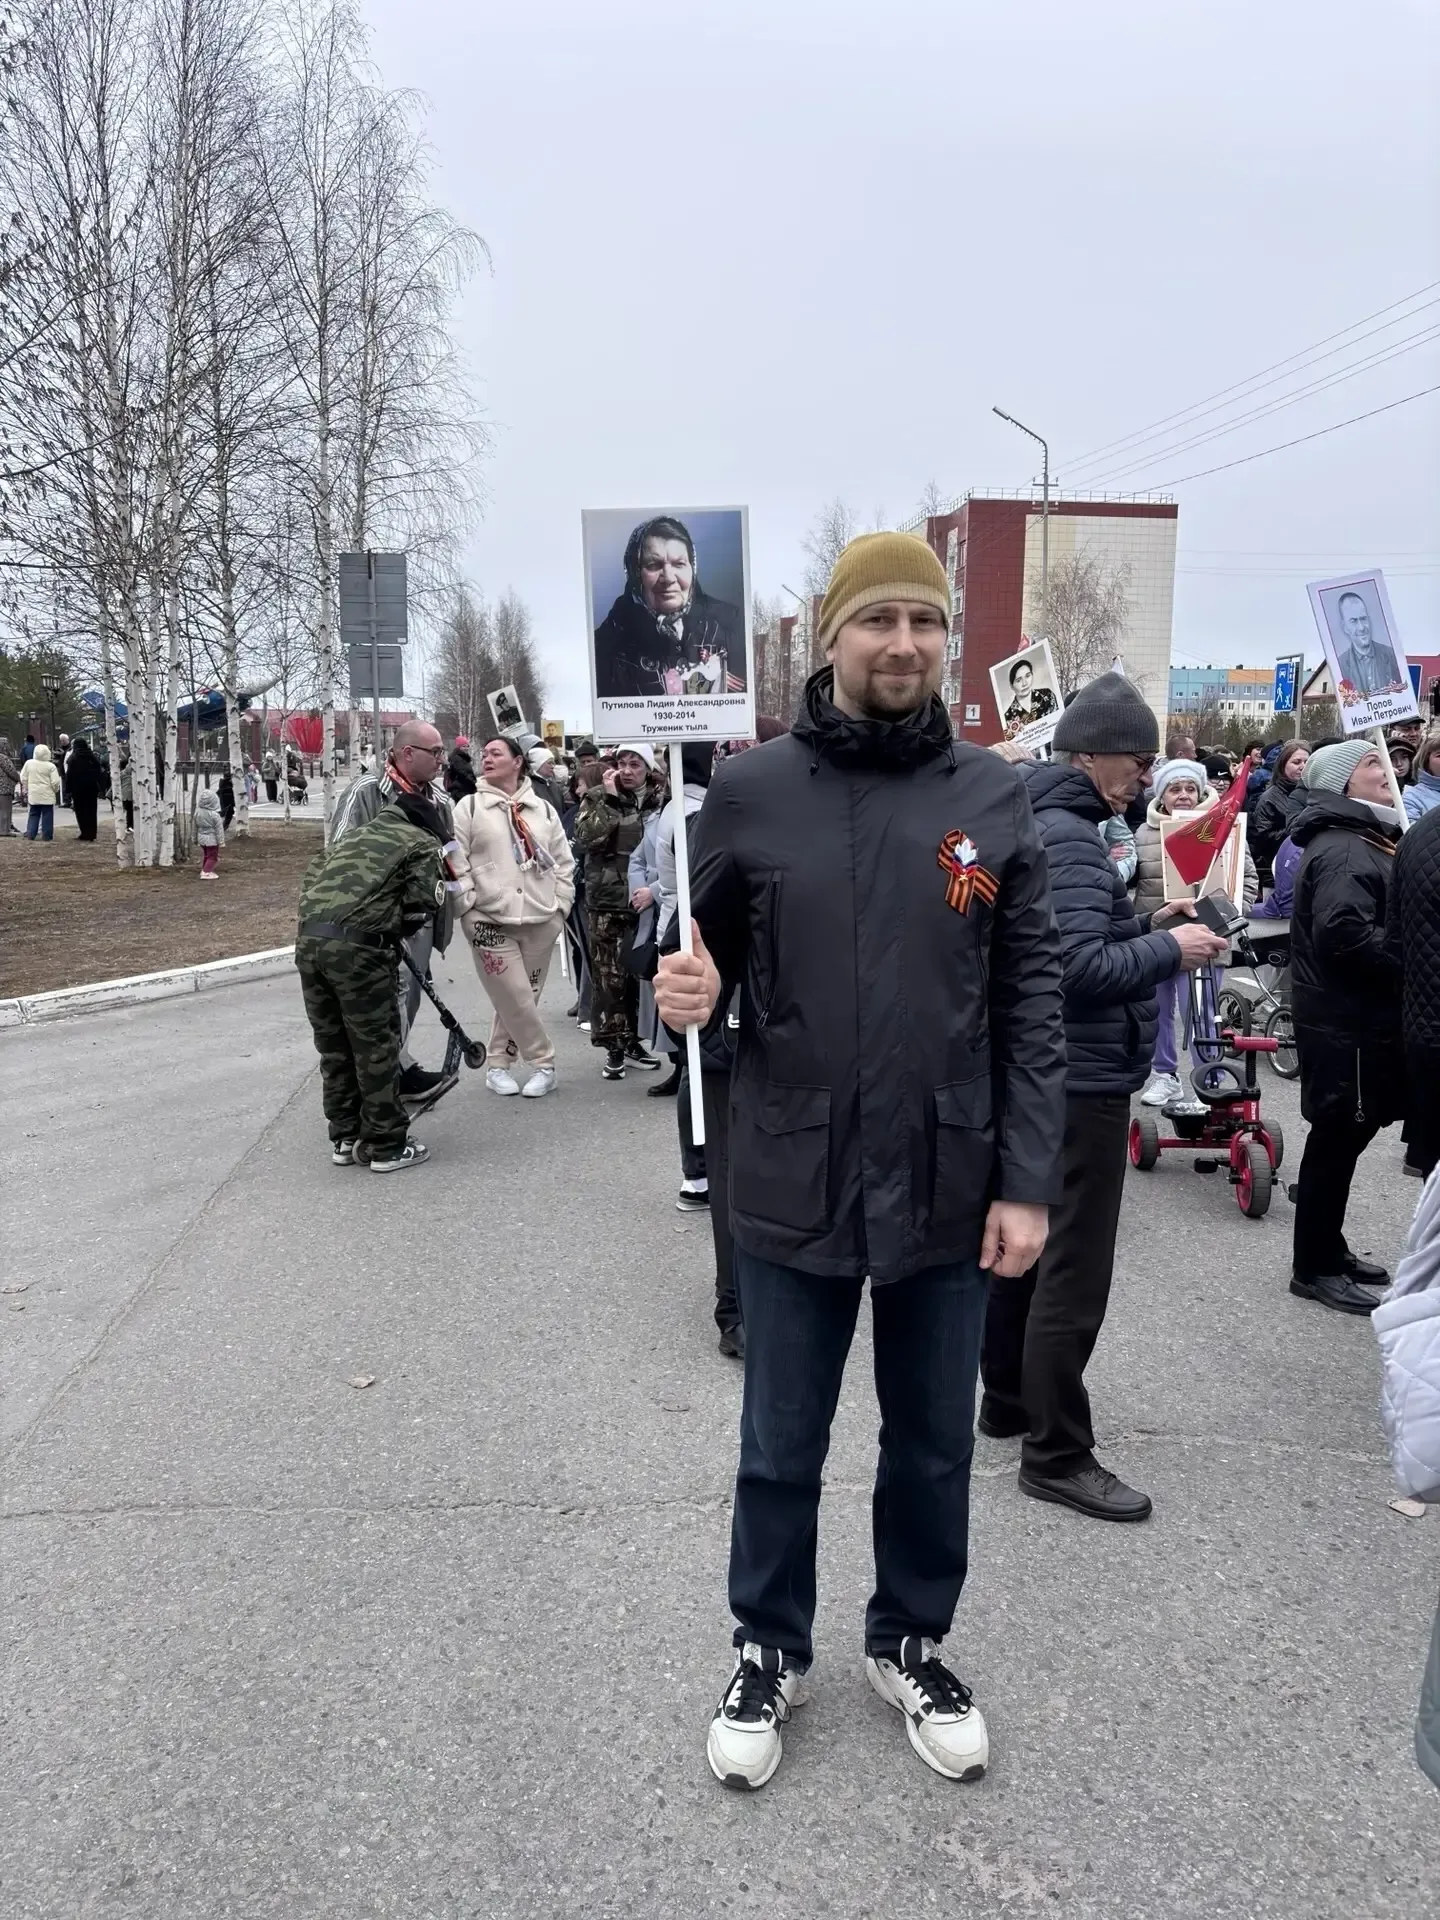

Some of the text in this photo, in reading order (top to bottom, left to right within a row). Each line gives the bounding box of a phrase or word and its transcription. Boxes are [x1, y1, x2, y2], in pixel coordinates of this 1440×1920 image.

[601, 698, 746, 711] Путилова Лидия Александровна
[1366, 699, 1393, 712] Попов
[653, 711, 696, 720] 1930-2014
[1351, 704, 1413, 727] Иван Петрович
[641, 724, 684, 734] Труженик
